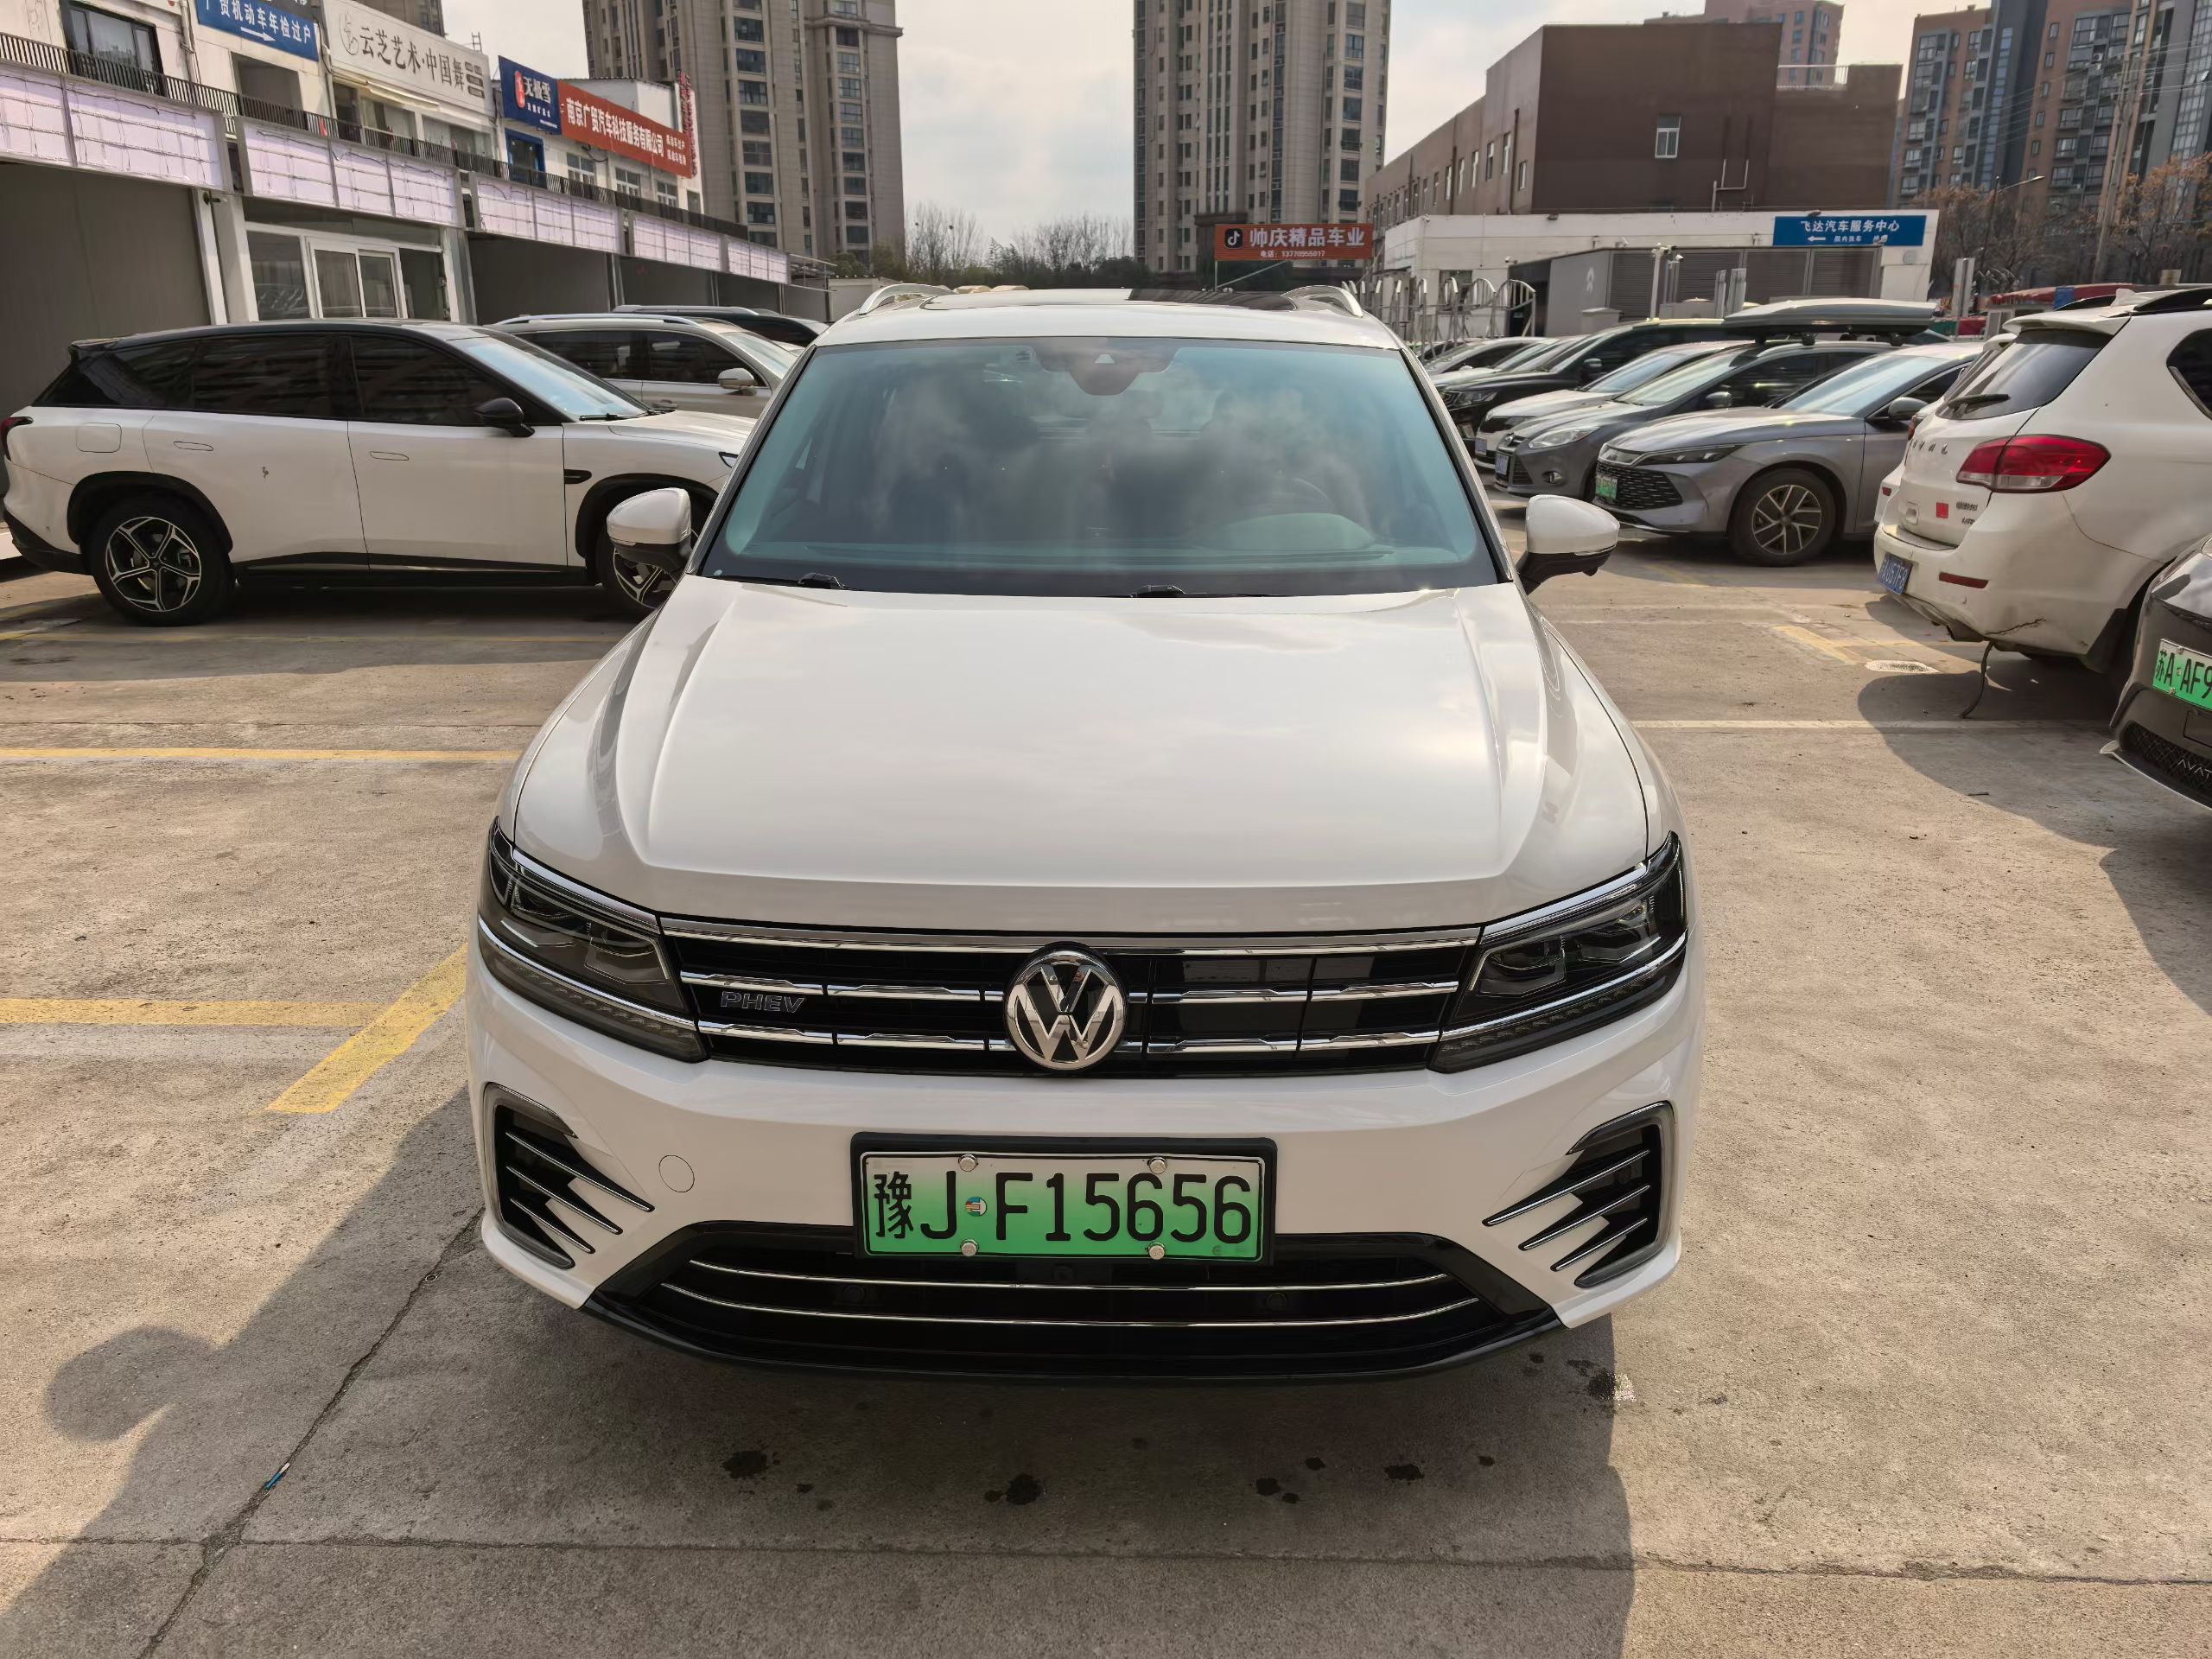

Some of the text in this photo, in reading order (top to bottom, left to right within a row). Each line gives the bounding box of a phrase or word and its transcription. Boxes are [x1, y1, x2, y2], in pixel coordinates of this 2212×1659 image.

[1801, 219, 1900, 232] 飞达汽车服务中心
[1249, 227, 1364, 247] 帅庆精品车业
[720, 990, 806, 1014] PHEV
